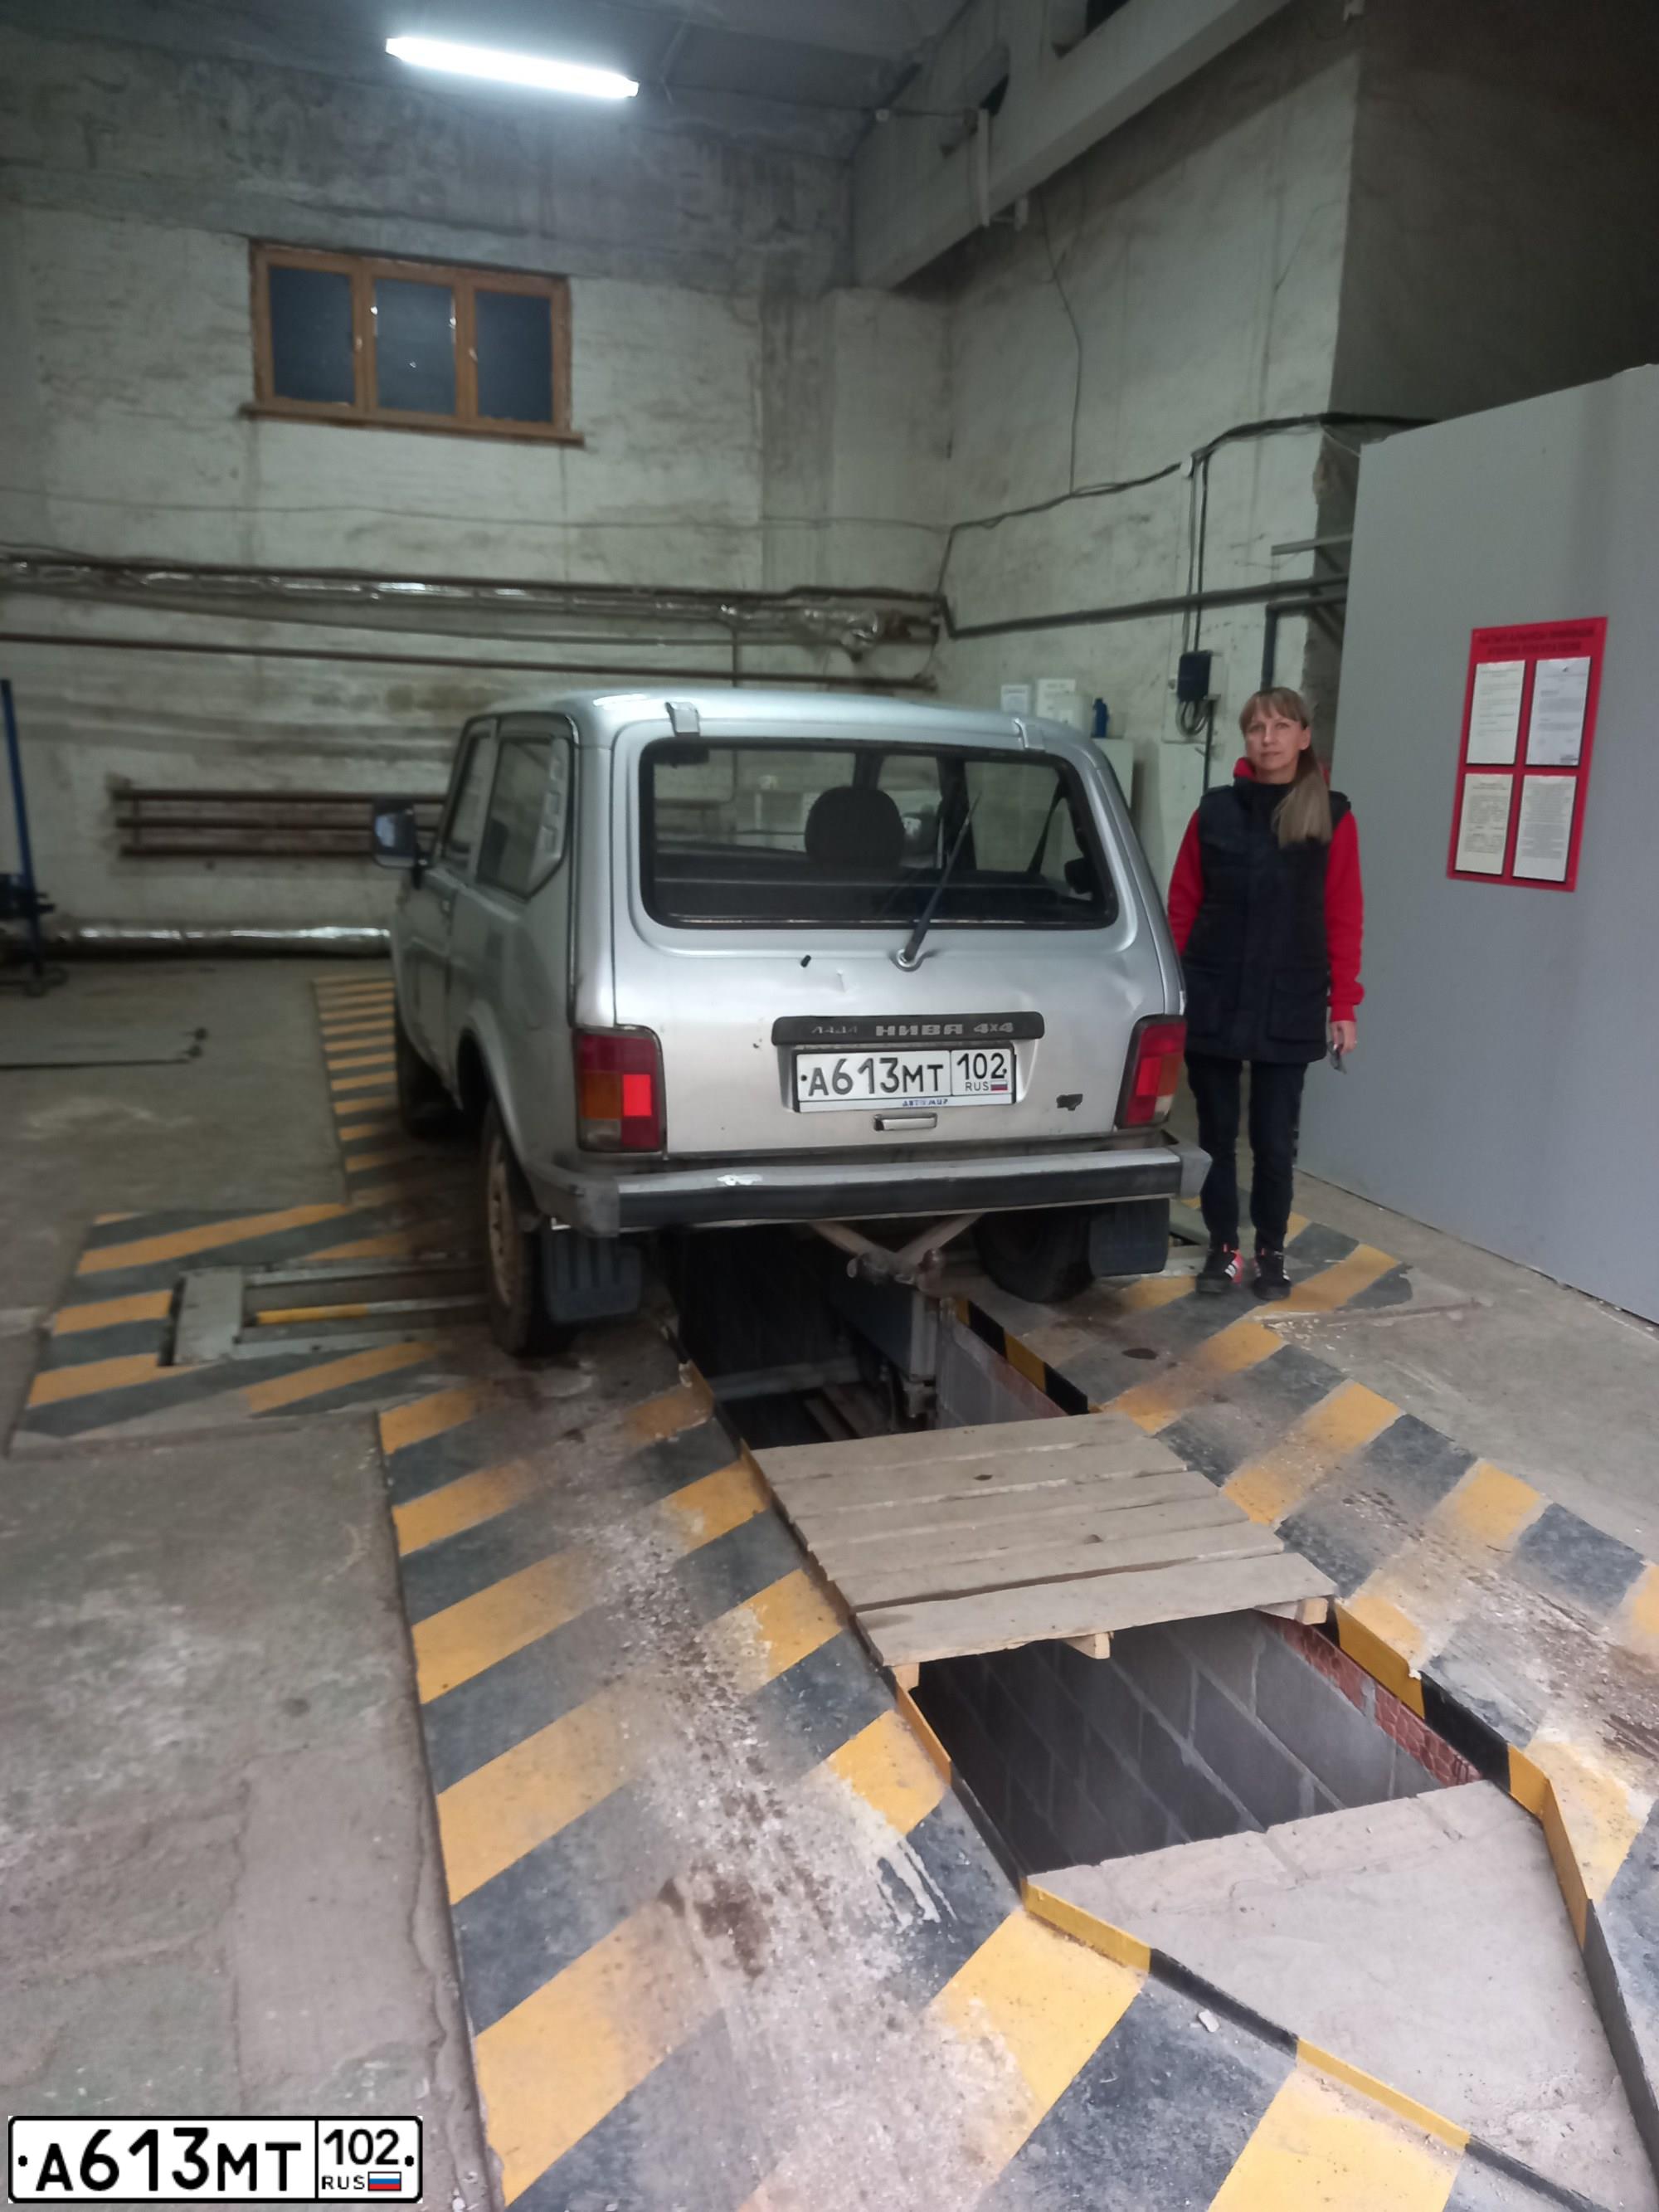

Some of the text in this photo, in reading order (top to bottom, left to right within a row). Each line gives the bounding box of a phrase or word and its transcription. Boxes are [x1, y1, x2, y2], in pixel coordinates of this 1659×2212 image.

[876, 1024, 963, 1036] НИВА
[808, 1053, 1005, 1097] А613МТ 102
[965, 1081, 989, 1091] RUS
